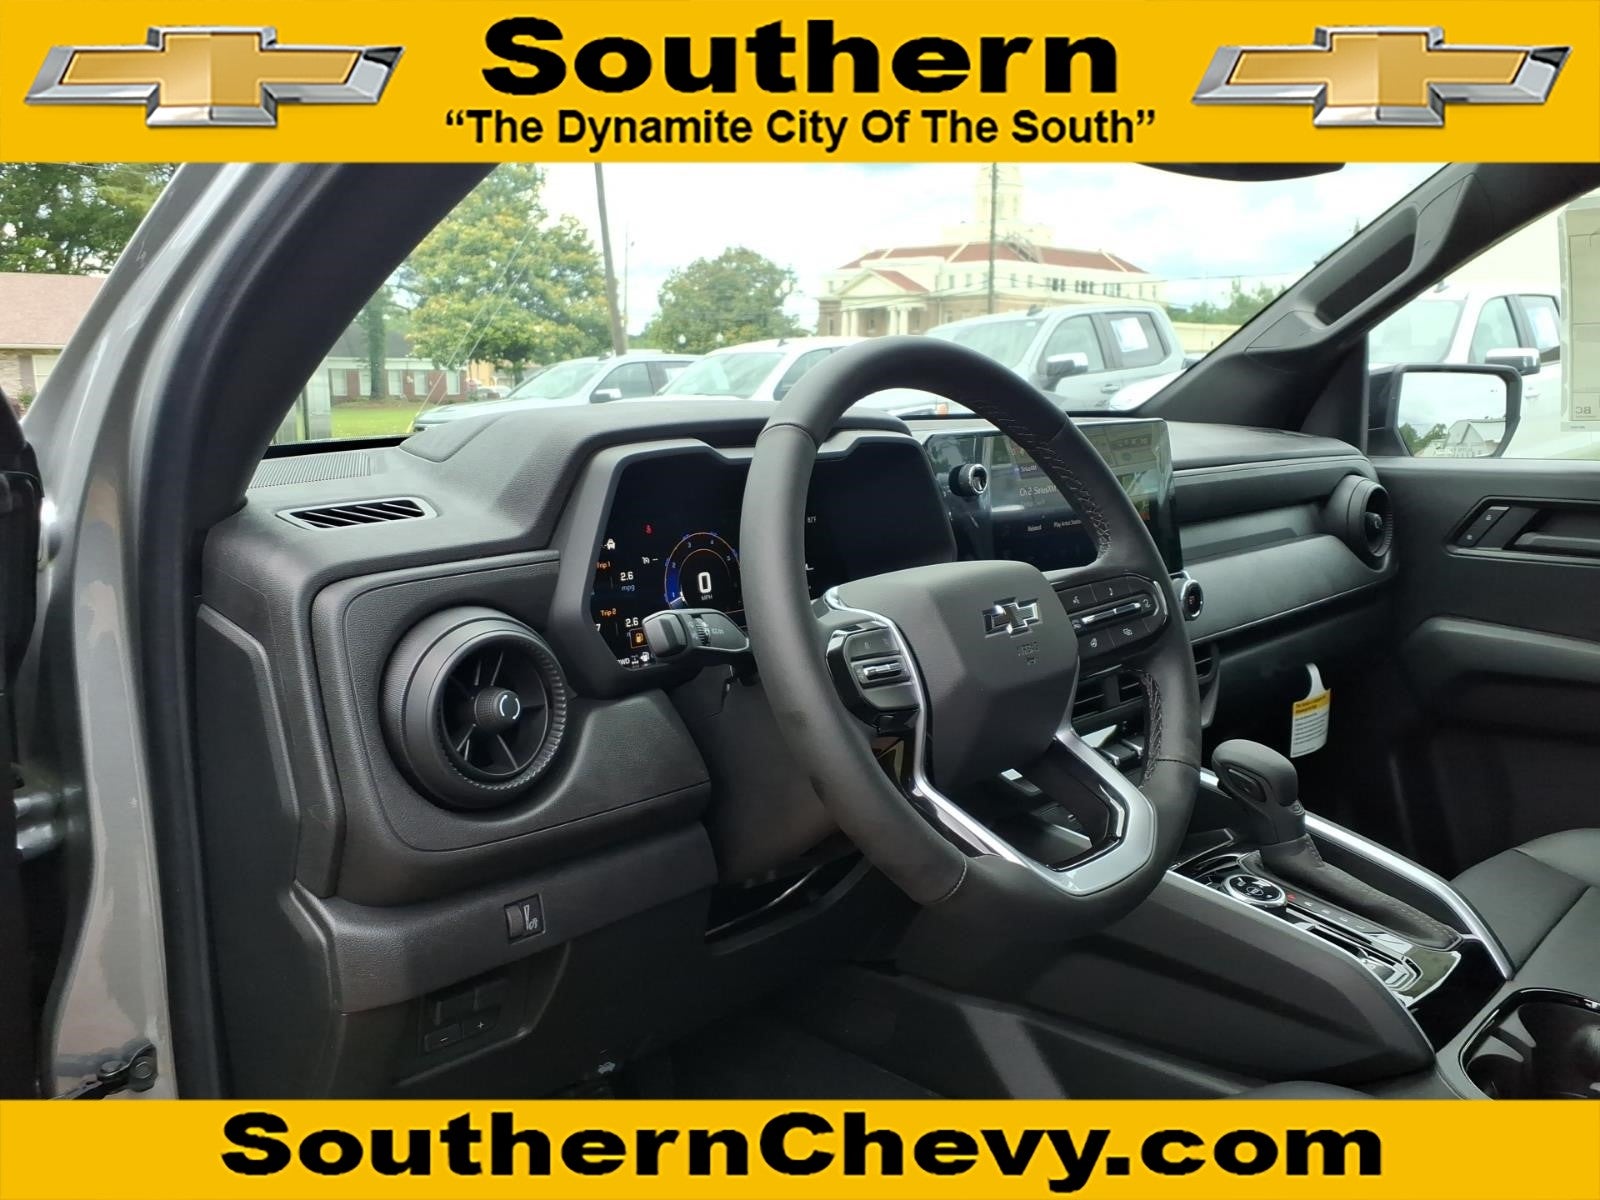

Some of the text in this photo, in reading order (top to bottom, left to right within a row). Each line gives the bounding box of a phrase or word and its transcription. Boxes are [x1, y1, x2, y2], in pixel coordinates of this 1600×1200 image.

[620, 571, 634, 581] 2.6
[698, 572, 712, 593] 0
[625, 617, 639, 627] 2.6
